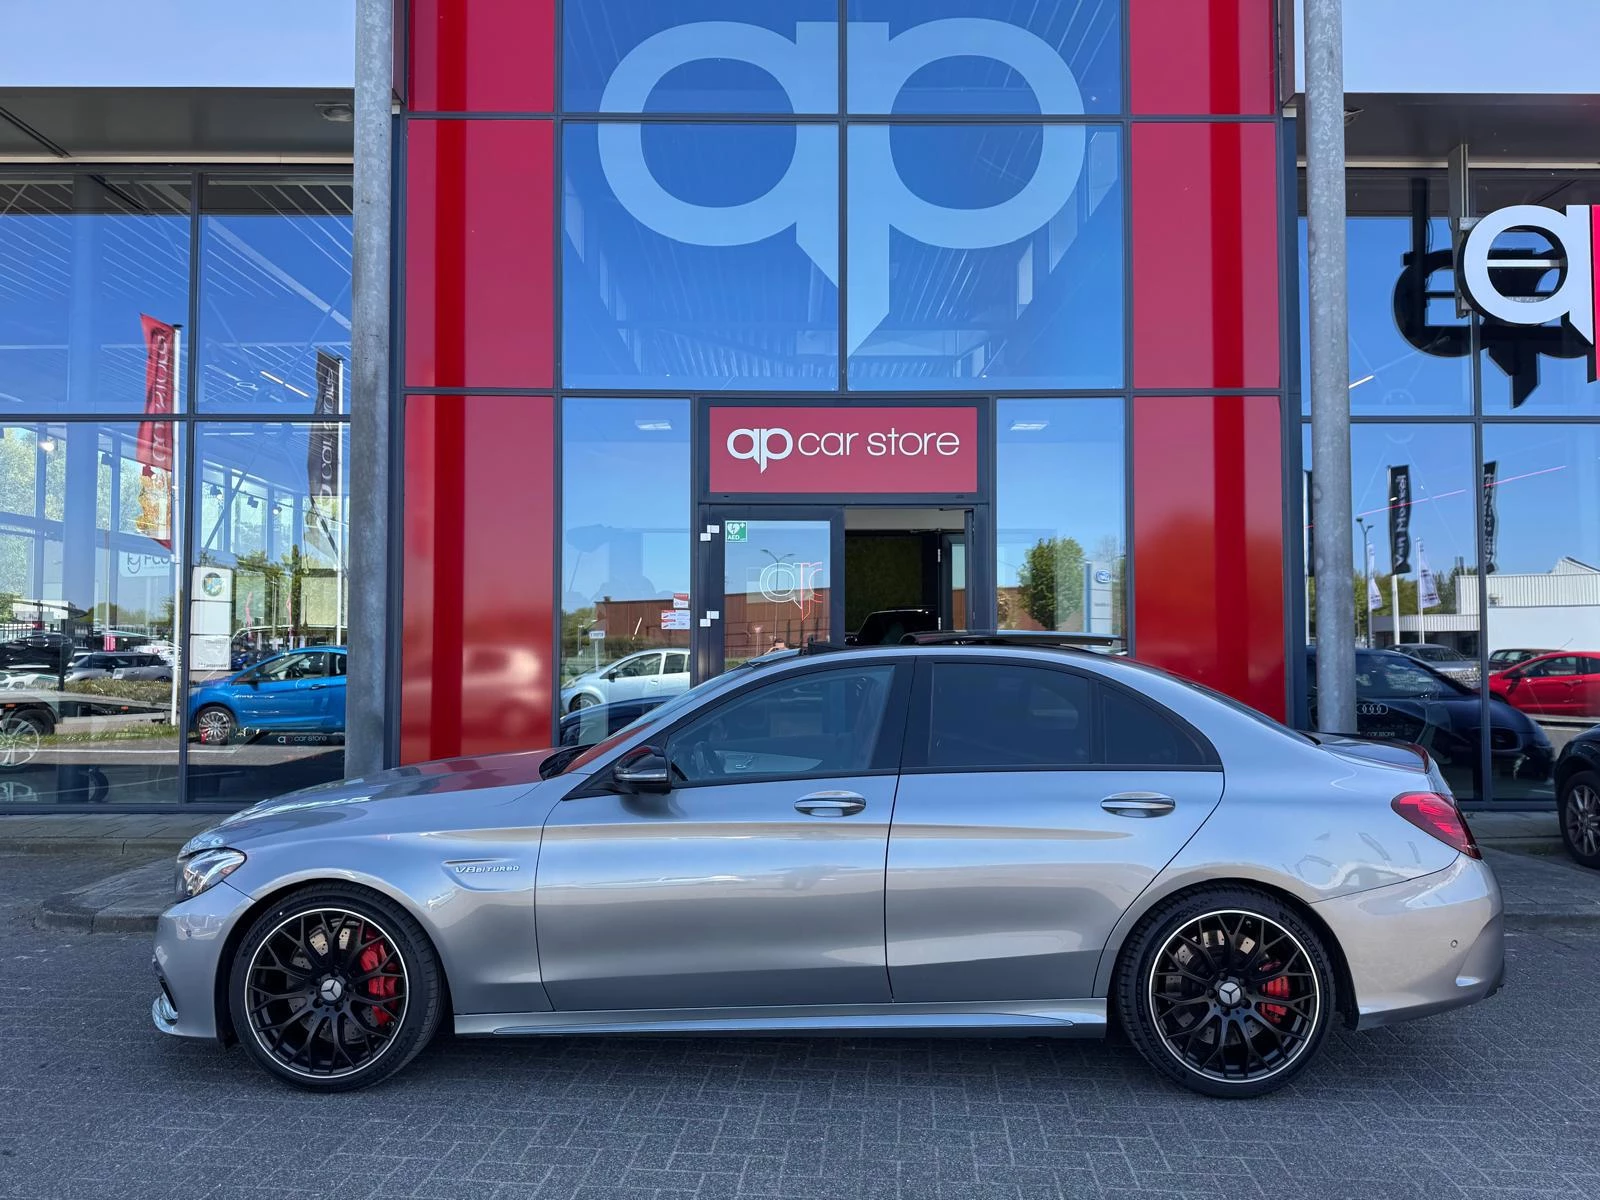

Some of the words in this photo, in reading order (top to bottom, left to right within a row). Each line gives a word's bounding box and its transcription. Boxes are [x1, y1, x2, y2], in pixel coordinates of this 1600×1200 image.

[727, 427, 793, 474] ap
[798, 432, 859, 456] car
[867, 427, 960, 456] store
